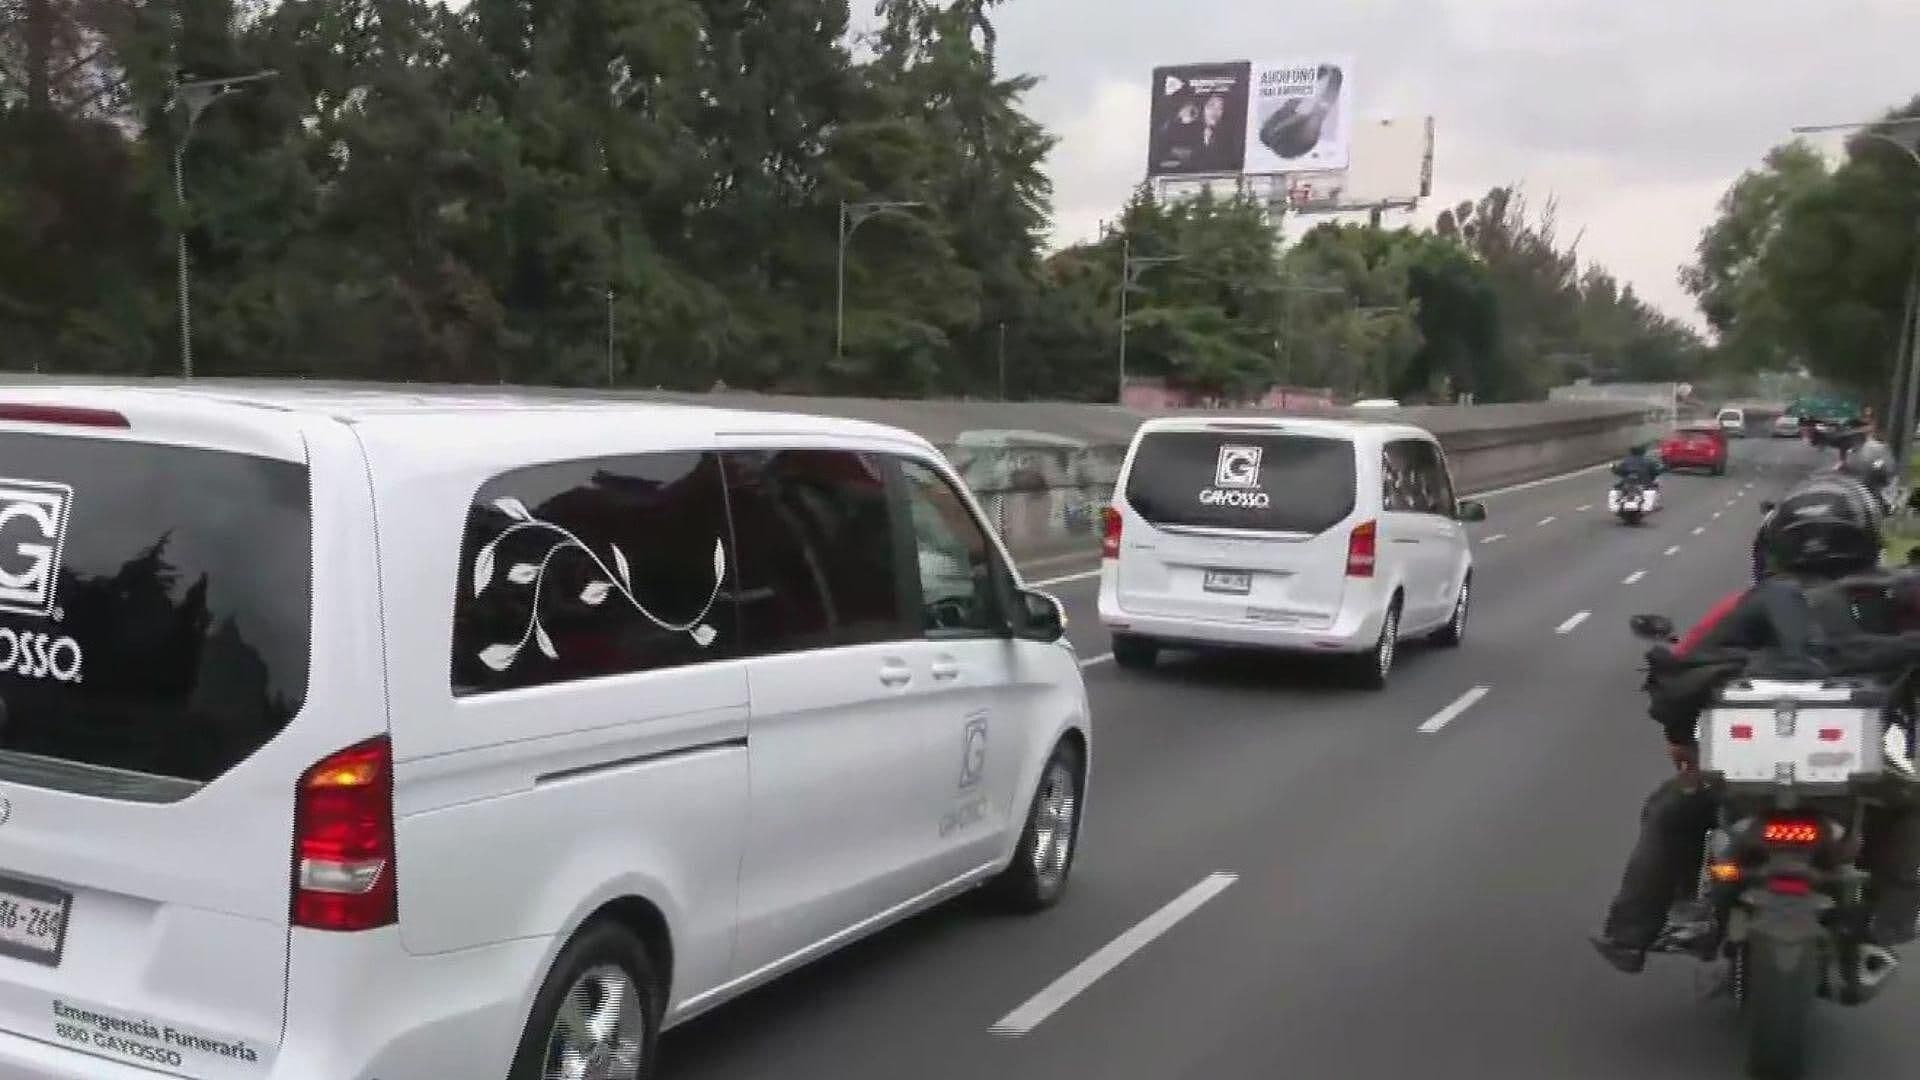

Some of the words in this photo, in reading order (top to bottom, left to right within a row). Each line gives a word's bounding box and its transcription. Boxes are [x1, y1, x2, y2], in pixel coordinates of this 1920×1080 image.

[1199, 488, 1270, 508] GAYOSSO
[53, 999, 159, 1041] Emergencia
[163, 1025, 258, 1062] Funeraria
[55, 1022, 89, 1045] 800
[93, 1033, 183, 1067] GAYOSSO
